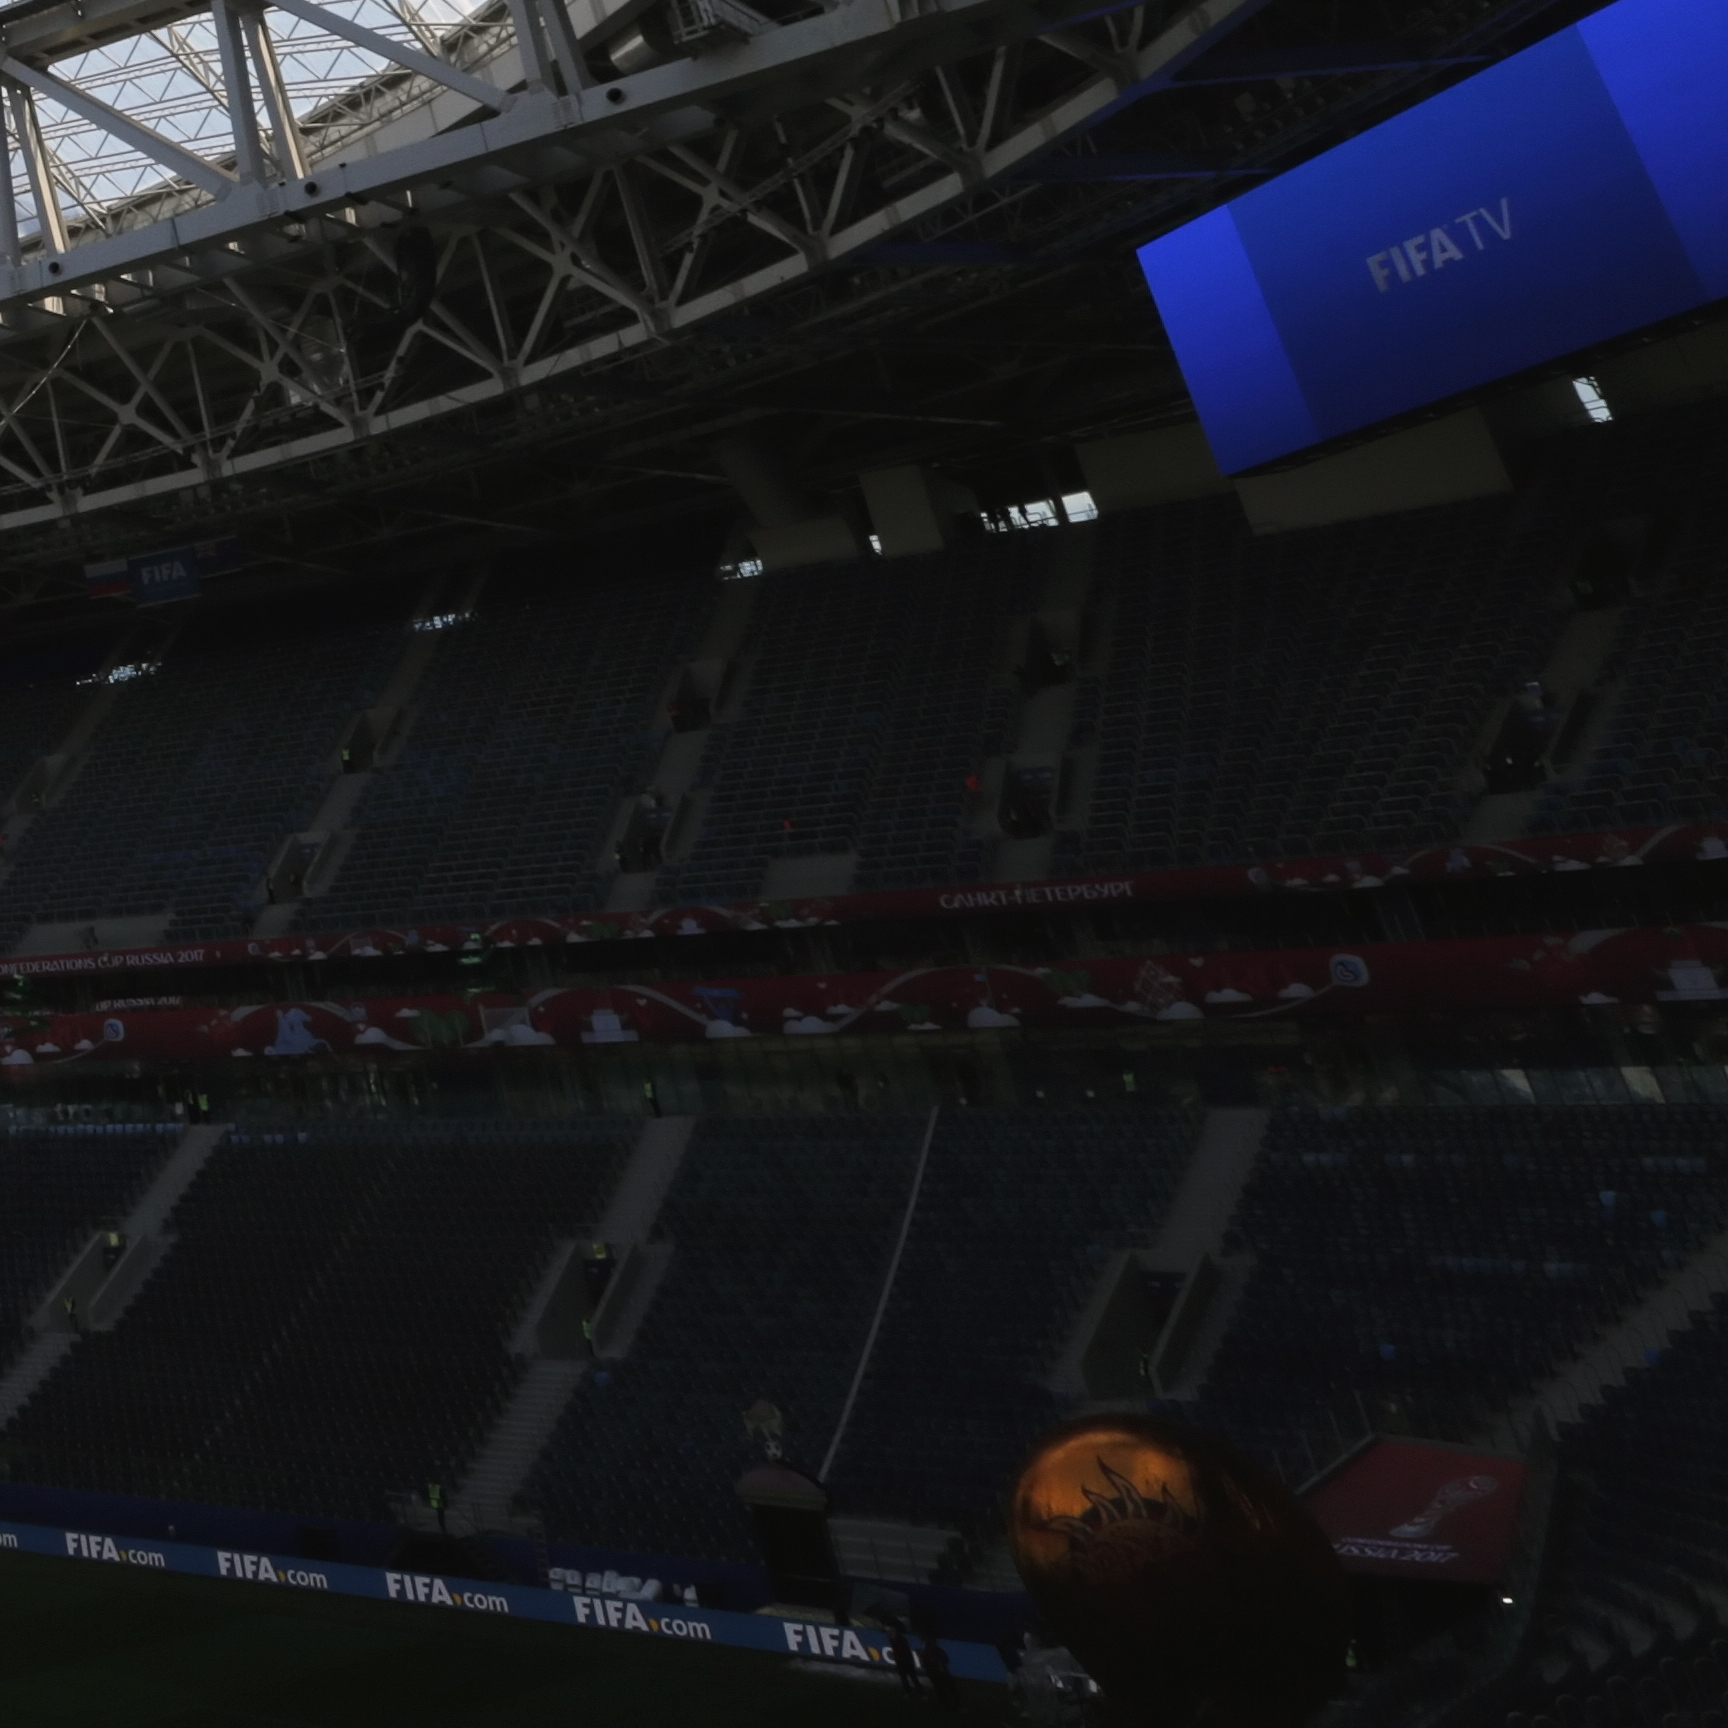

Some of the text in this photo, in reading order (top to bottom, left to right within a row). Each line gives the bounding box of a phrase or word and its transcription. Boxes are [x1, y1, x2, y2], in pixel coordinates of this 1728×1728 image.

[1366, 197, 1512, 293] FIFA TV
[141, 560, 187, 585] FIFA
[939, 881, 1134, 909] САНКТ-ПЕТЕРБУРГ
[97, 954, 124, 969] CUP
[126, 952, 174, 967] RUSSIA
[177, 949, 205, 963] 2017
[65, 1532, 165, 1568] FIFA.com
[217, 1551, 328, 1589] FIFA.com
[385, 1572, 509, 1613] FIFA.com
[572, 1595, 711, 1641] FIFA.com
[783, 1621, 922, 1669] FIFA.c
